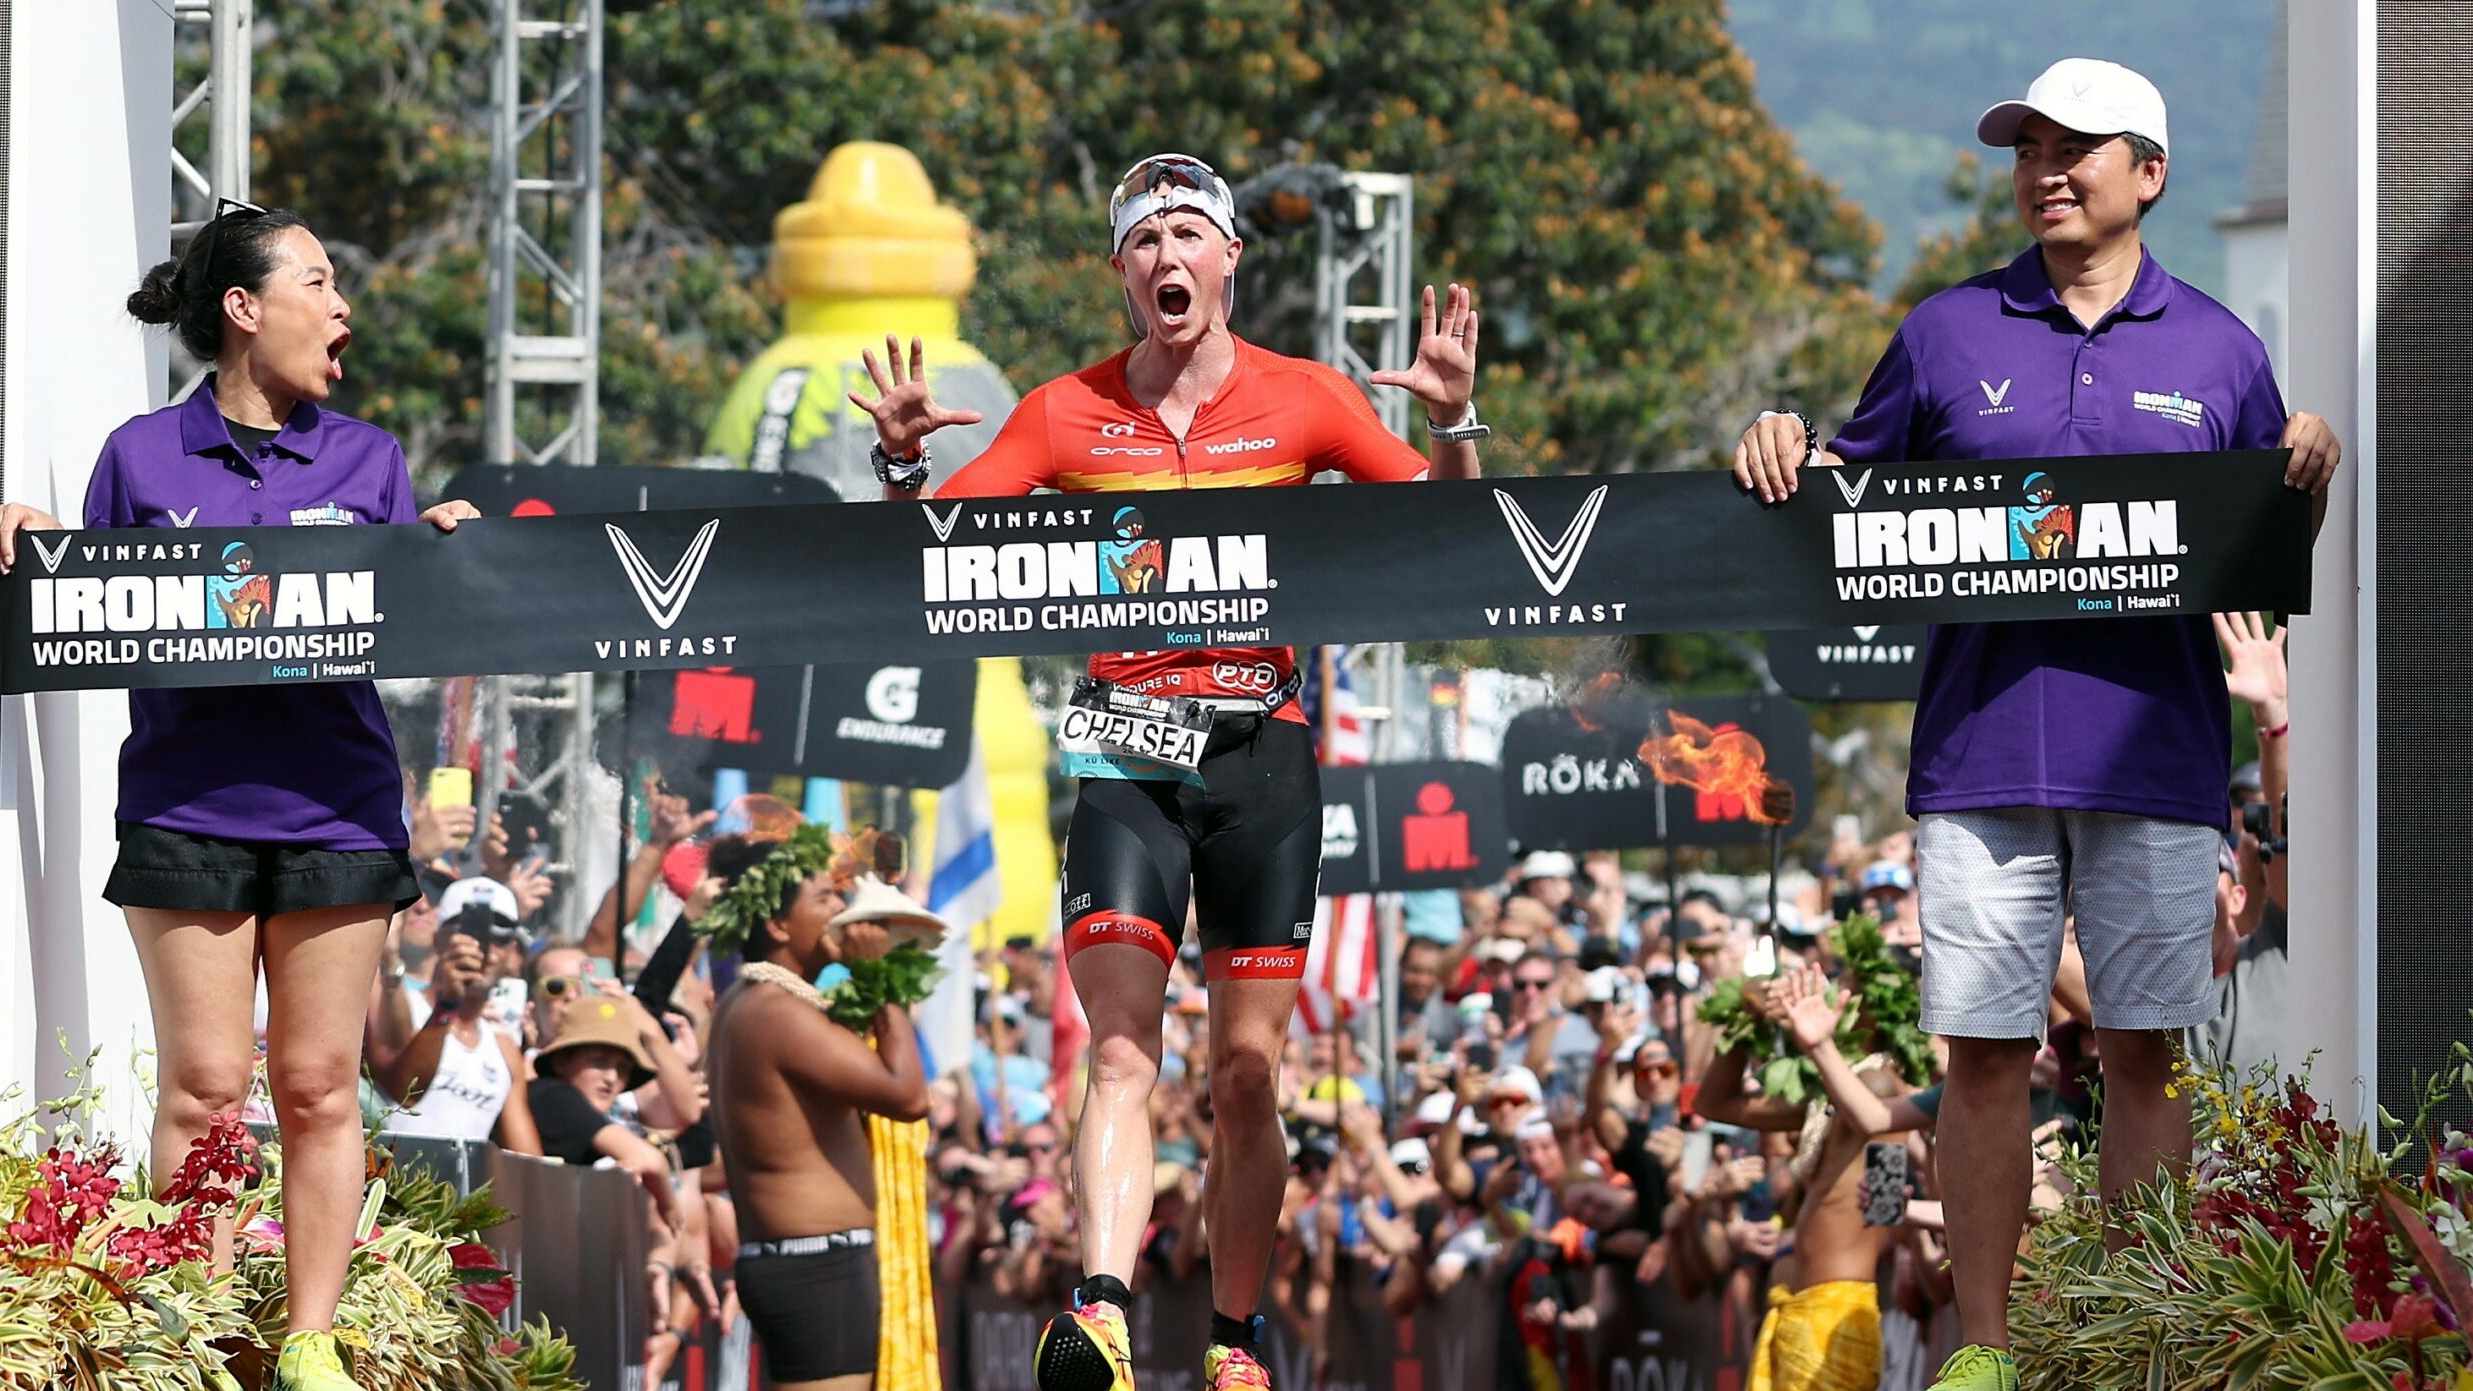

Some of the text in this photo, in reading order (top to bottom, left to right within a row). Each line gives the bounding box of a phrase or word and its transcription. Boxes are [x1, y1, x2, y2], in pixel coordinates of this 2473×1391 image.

[1090, 447, 1164, 456] orca
[1205, 437, 1276, 455] wahoo
[1882, 474, 2003, 495] VINFAST
[973, 508, 1093, 530] VINFAST
[1831, 500, 2179, 569] IRONMAN
[82, 542, 203, 562] VINFAST
[922, 534, 1269, 603] IRONMAN
[1835, 563, 2180, 601] WORLD CHAMPIONSHIP
[30, 570, 375, 634] IRONMAN
[2077, 597, 2112, 611] Kona
[924, 597, 1270, 635] WORLD CHAMPIONSHIP
[1484, 602, 1627, 626] VINFAST
[32, 630, 376, 667] WORLD CHAMPIONSHIP
[594, 635, 738, 660] VINFAST
[1166, 631, 1201, 645] Kona
[1816, 644, 1917, 664] VINFAST
[272, 664, 308, 678] Kona
[1217, 664, 1273, 684] PTO
[836, 717, 947, 749] ENDURANCE
[1064, 710, 1196, 764] CHELSEA
[1089, 921, 1155, 941] DT SWISS
[1231, 956, 1296, 968] DT SWISS
